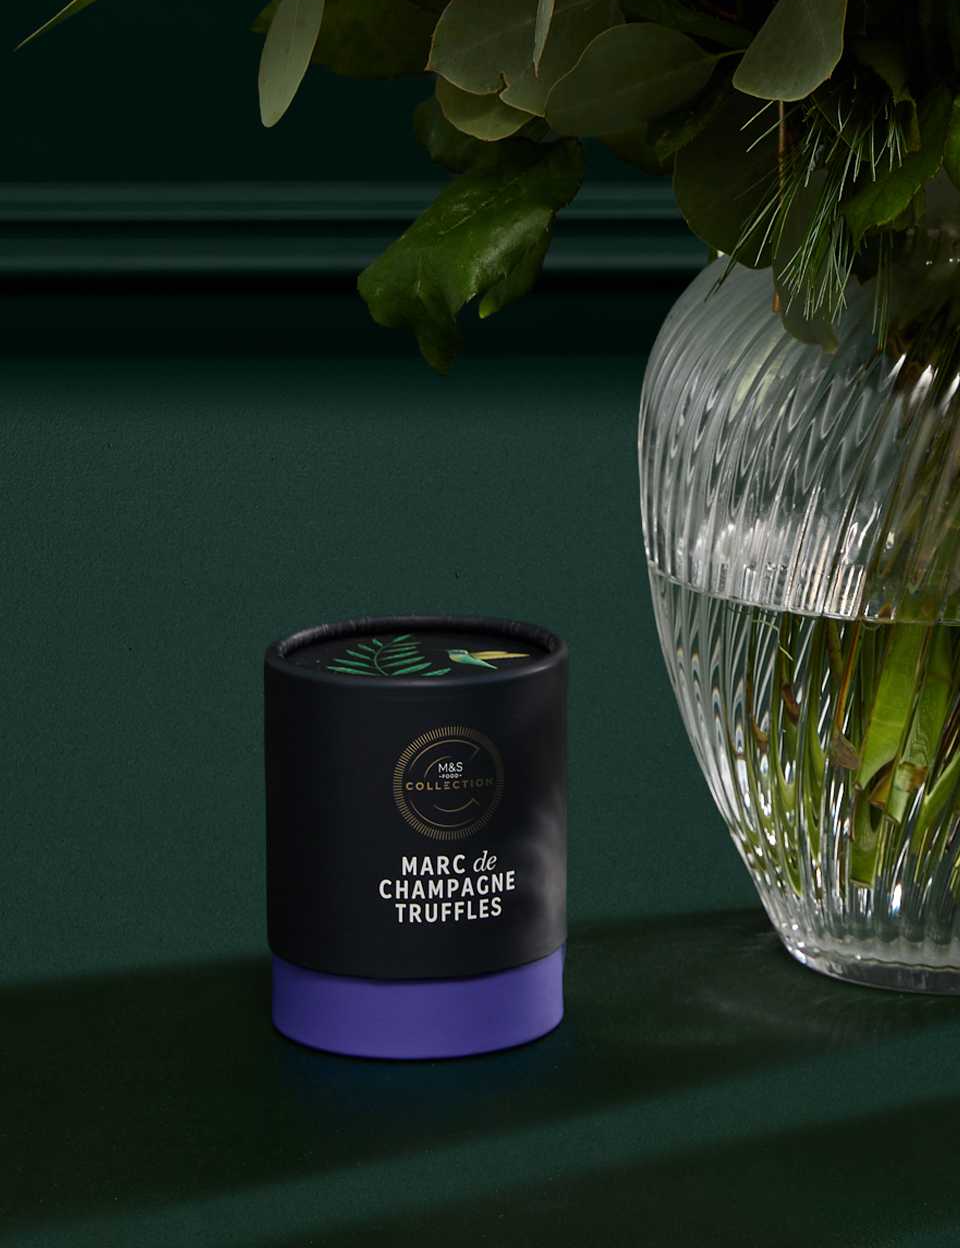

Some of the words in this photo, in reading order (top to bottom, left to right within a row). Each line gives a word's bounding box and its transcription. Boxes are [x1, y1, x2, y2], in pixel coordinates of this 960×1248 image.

[438, 761, 463, 773] M&S
[405, 778, 494, 791] COLLECTION
[401, 854, 466, 876] MARC
[473, 850, 498, 873] de
[379, 870, 516, 900] CHAMPAGNE
[395, 897, 502, 923] TRUFFLES
